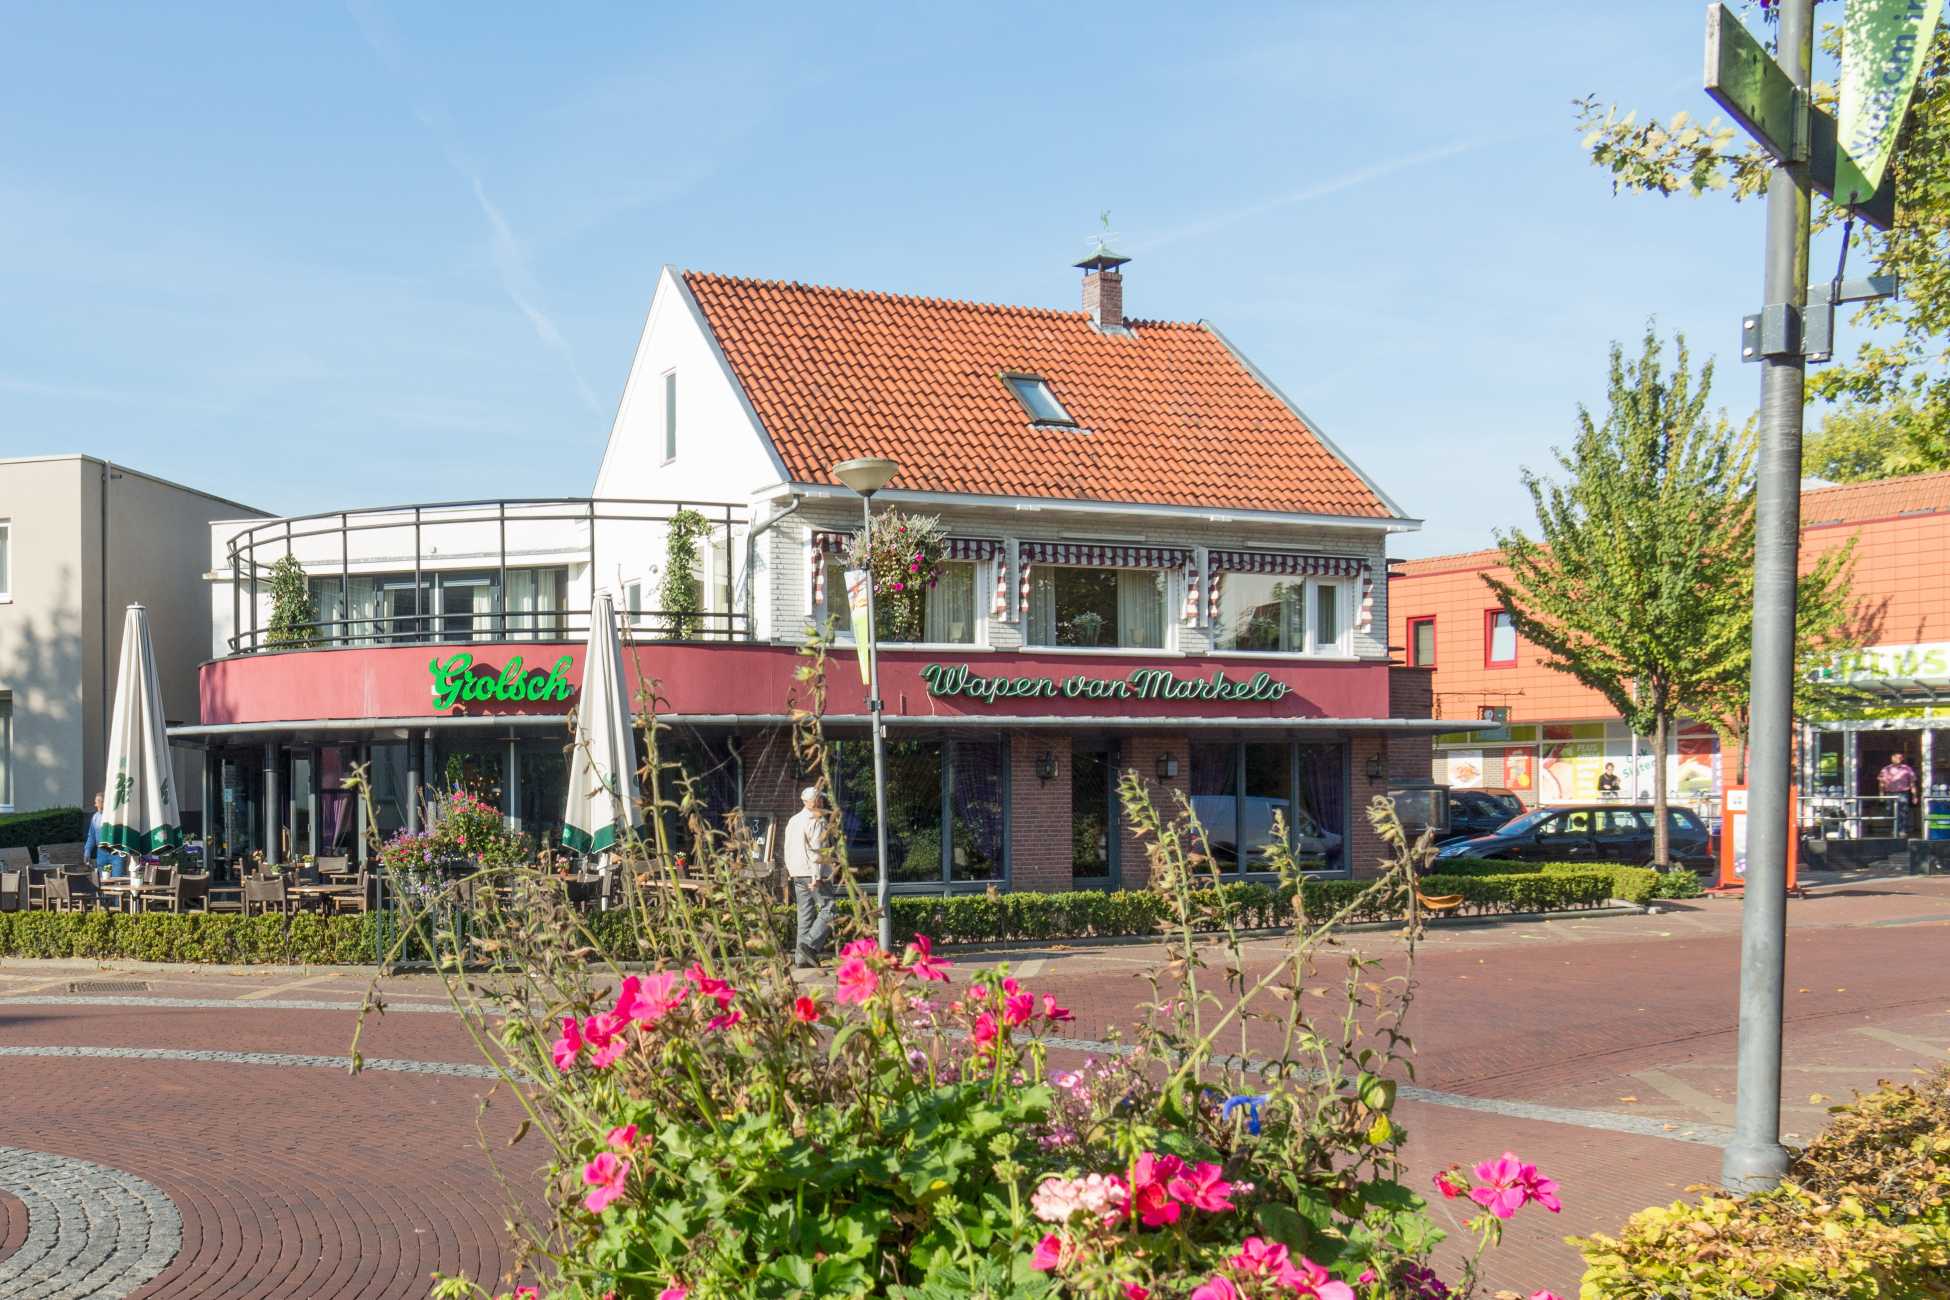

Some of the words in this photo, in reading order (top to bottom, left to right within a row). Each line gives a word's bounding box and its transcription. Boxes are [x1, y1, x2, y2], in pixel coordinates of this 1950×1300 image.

[429, 652, 573, 711] Grolsch
[919, 663, 1057, 704] Wapen
[1062, 675, 1133, 700] van
[1128, 668, 1296, 701] Markelo
